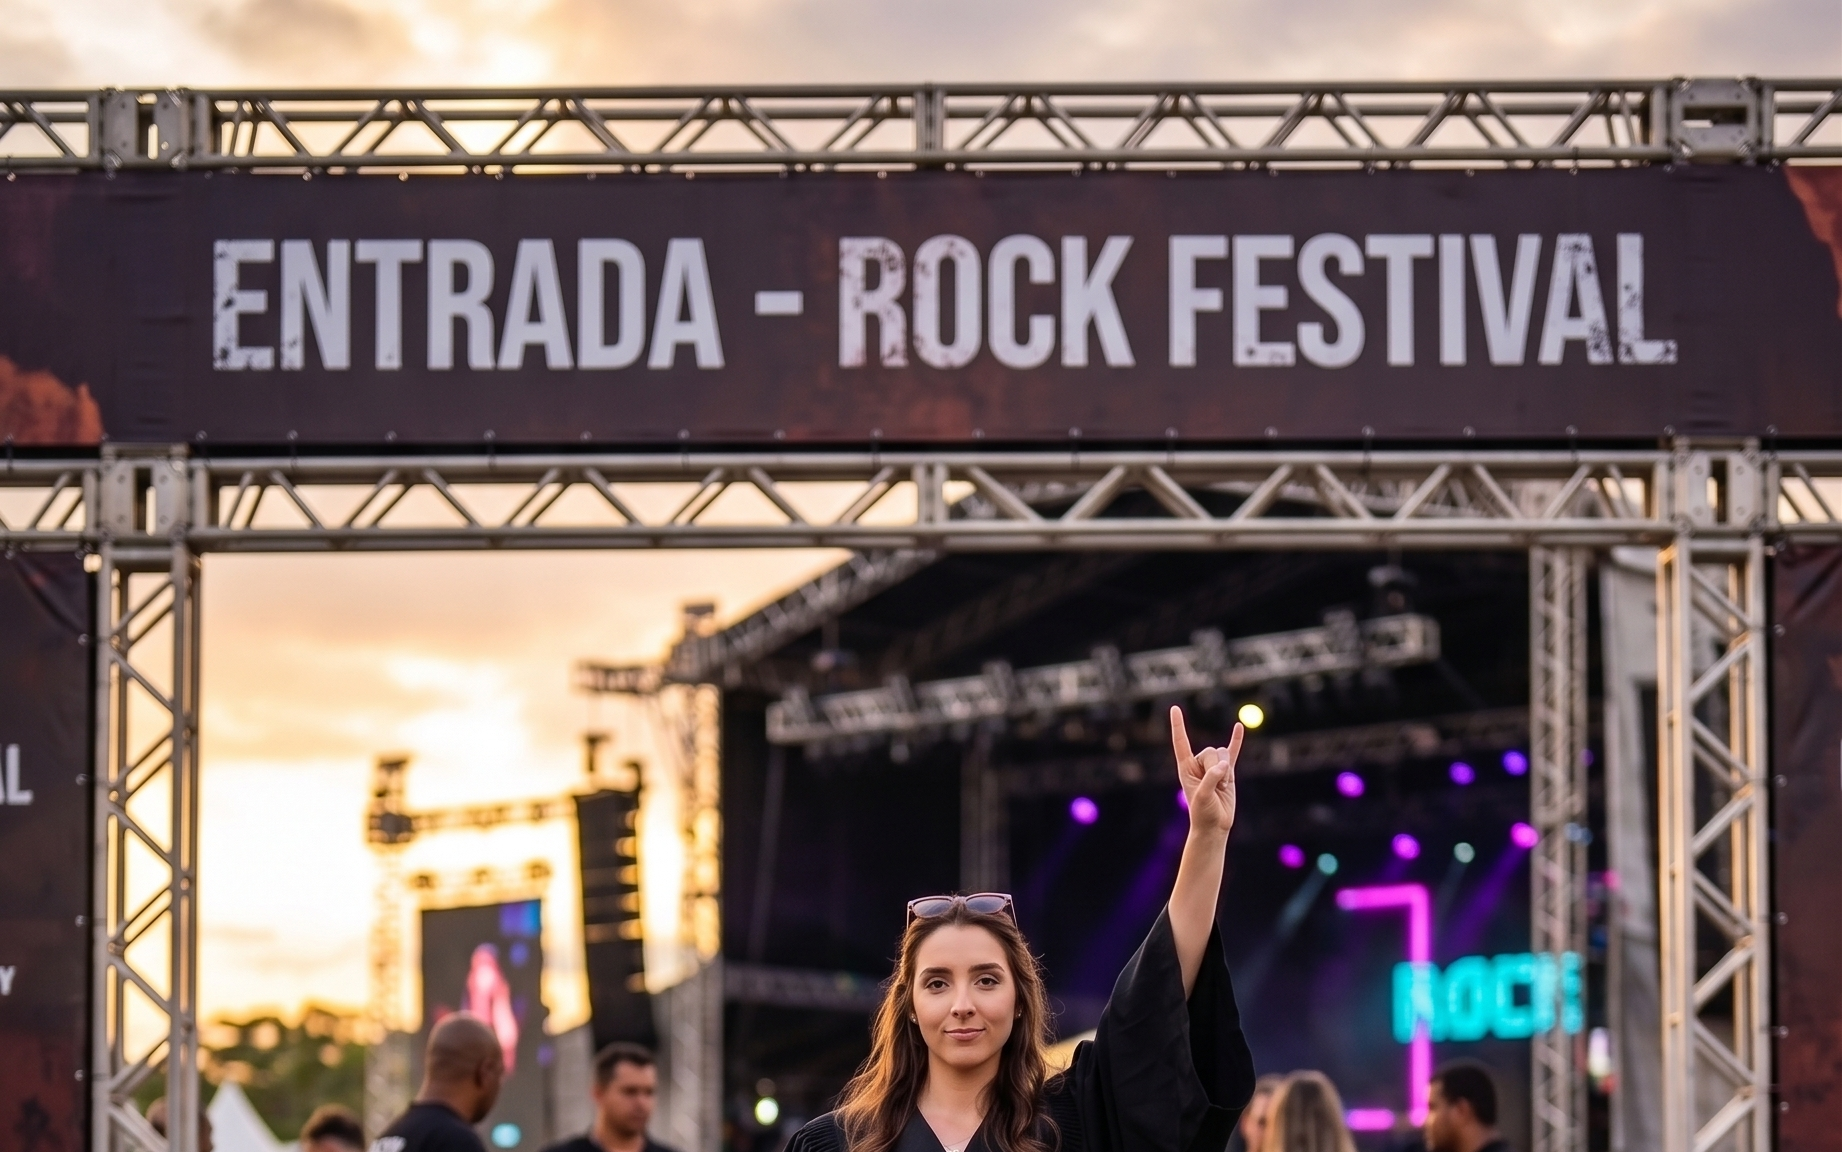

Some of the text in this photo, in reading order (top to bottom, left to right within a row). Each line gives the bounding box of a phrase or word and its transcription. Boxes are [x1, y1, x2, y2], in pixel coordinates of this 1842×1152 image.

[212, 232, 1678, 371] ENTRADA - ROCK FESTIVAL
[0, 743, 34, 805] L
